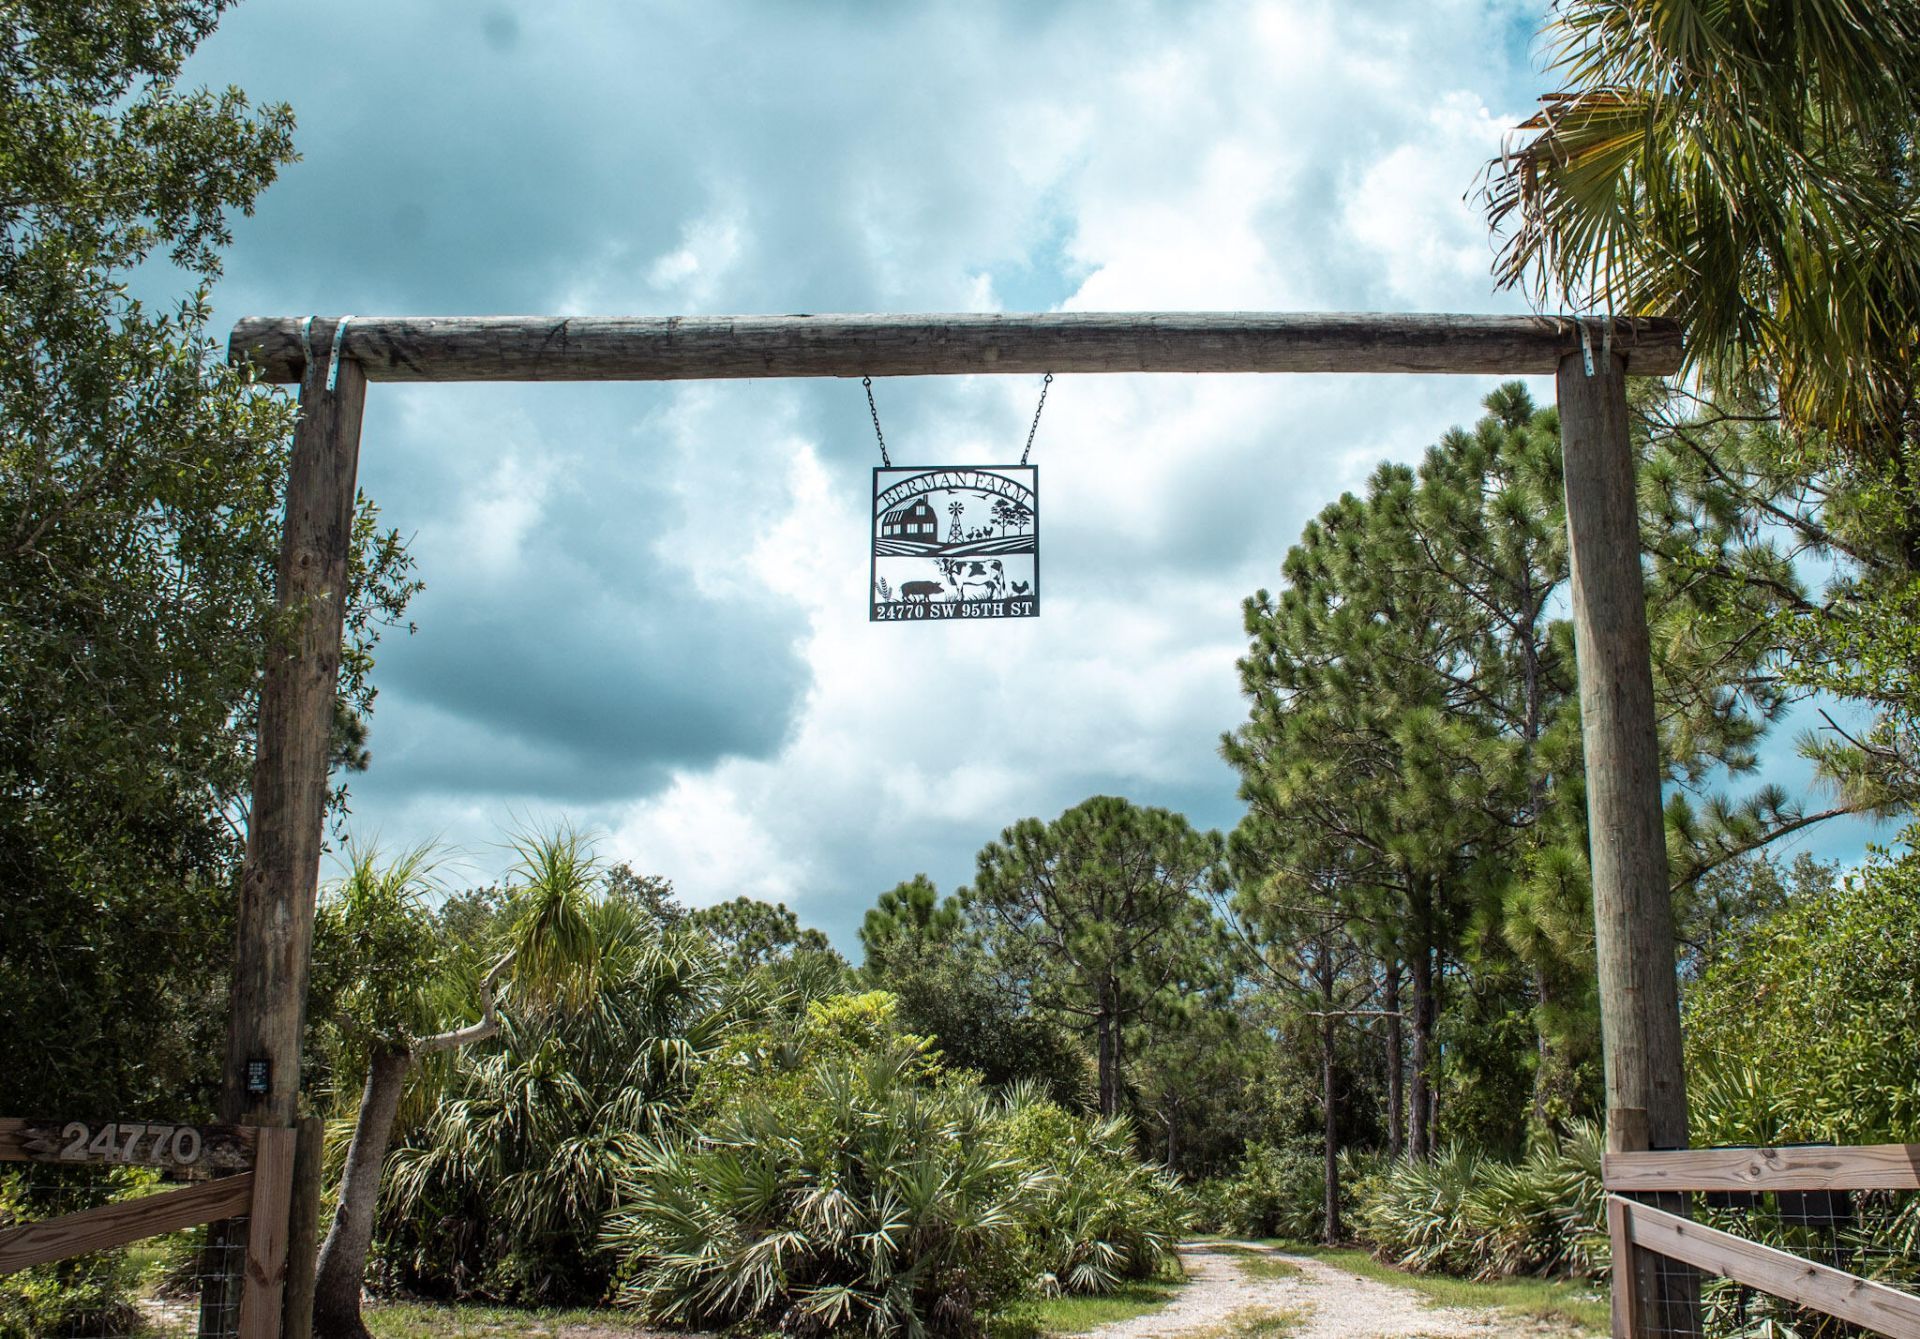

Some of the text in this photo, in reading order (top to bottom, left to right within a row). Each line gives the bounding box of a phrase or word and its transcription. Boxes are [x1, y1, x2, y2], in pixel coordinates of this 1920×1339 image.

[882, 472, 1029, 506] BERMAN FARM
[877, 602, 1033, 619] 24770 SW 95TH ST
[60, 1121, 200, 1165] 24770
